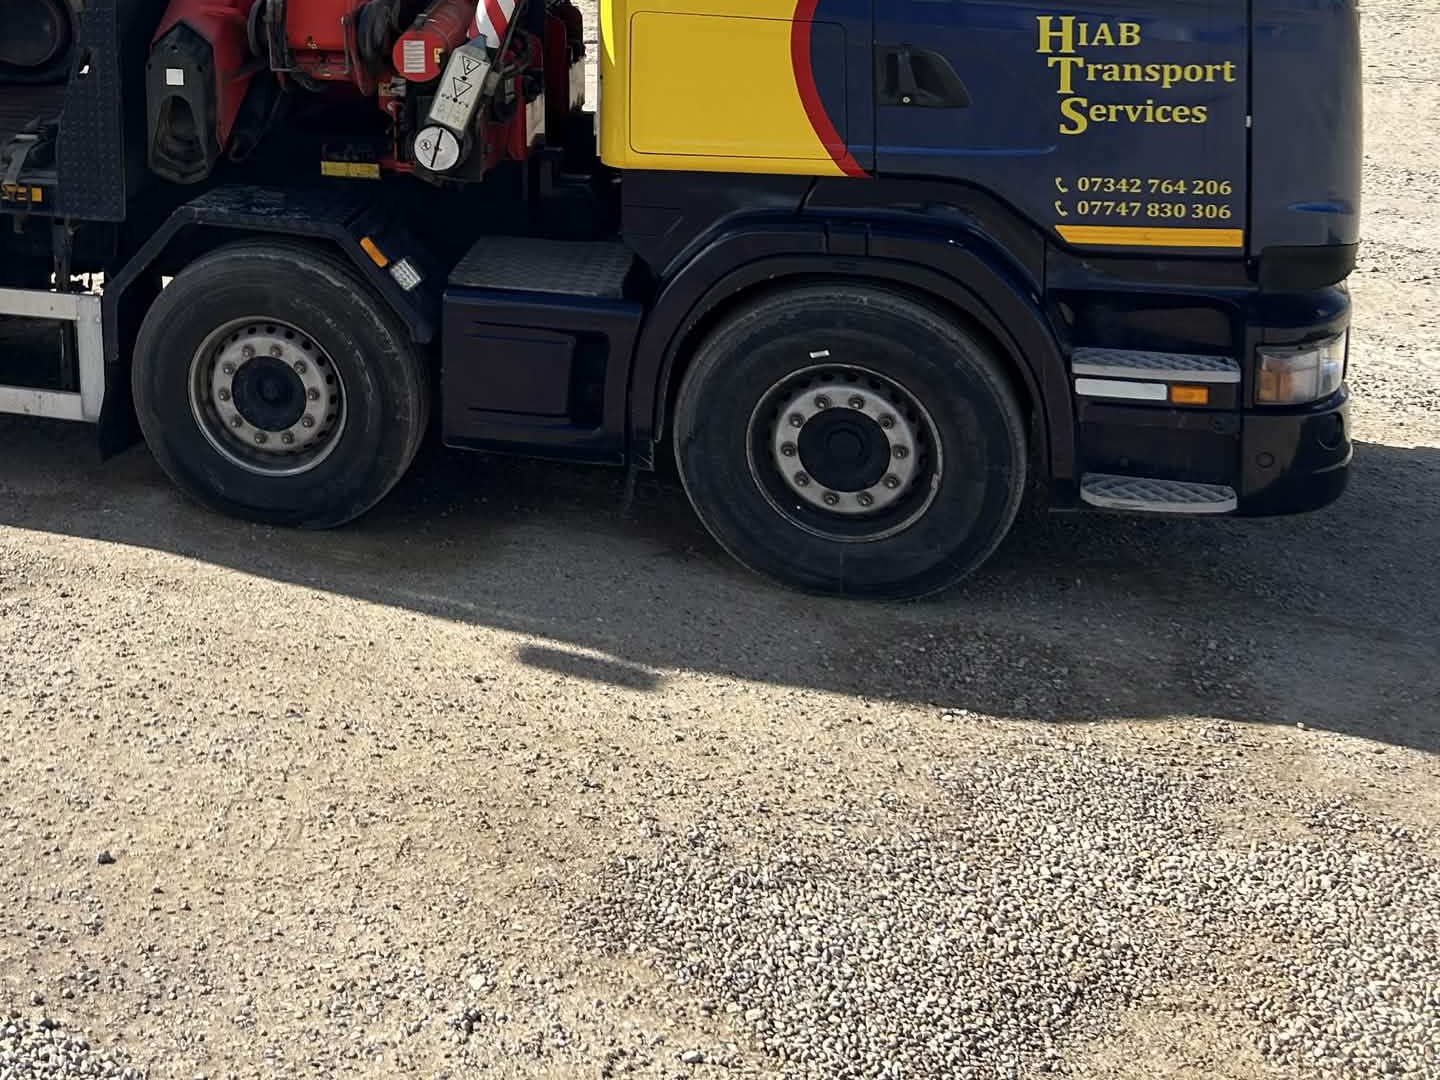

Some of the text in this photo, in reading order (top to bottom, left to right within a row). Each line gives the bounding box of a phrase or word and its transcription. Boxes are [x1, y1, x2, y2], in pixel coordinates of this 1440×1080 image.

[1036, 15, 1141, 53] HIAB
[1047, 56, 1237, 94] Transport
[1059, 96, 1208, 135] Services
[1076, 177, 1232, 195] 07342 764 206
[1076, 200, 1232, 219] 07747 830 306
